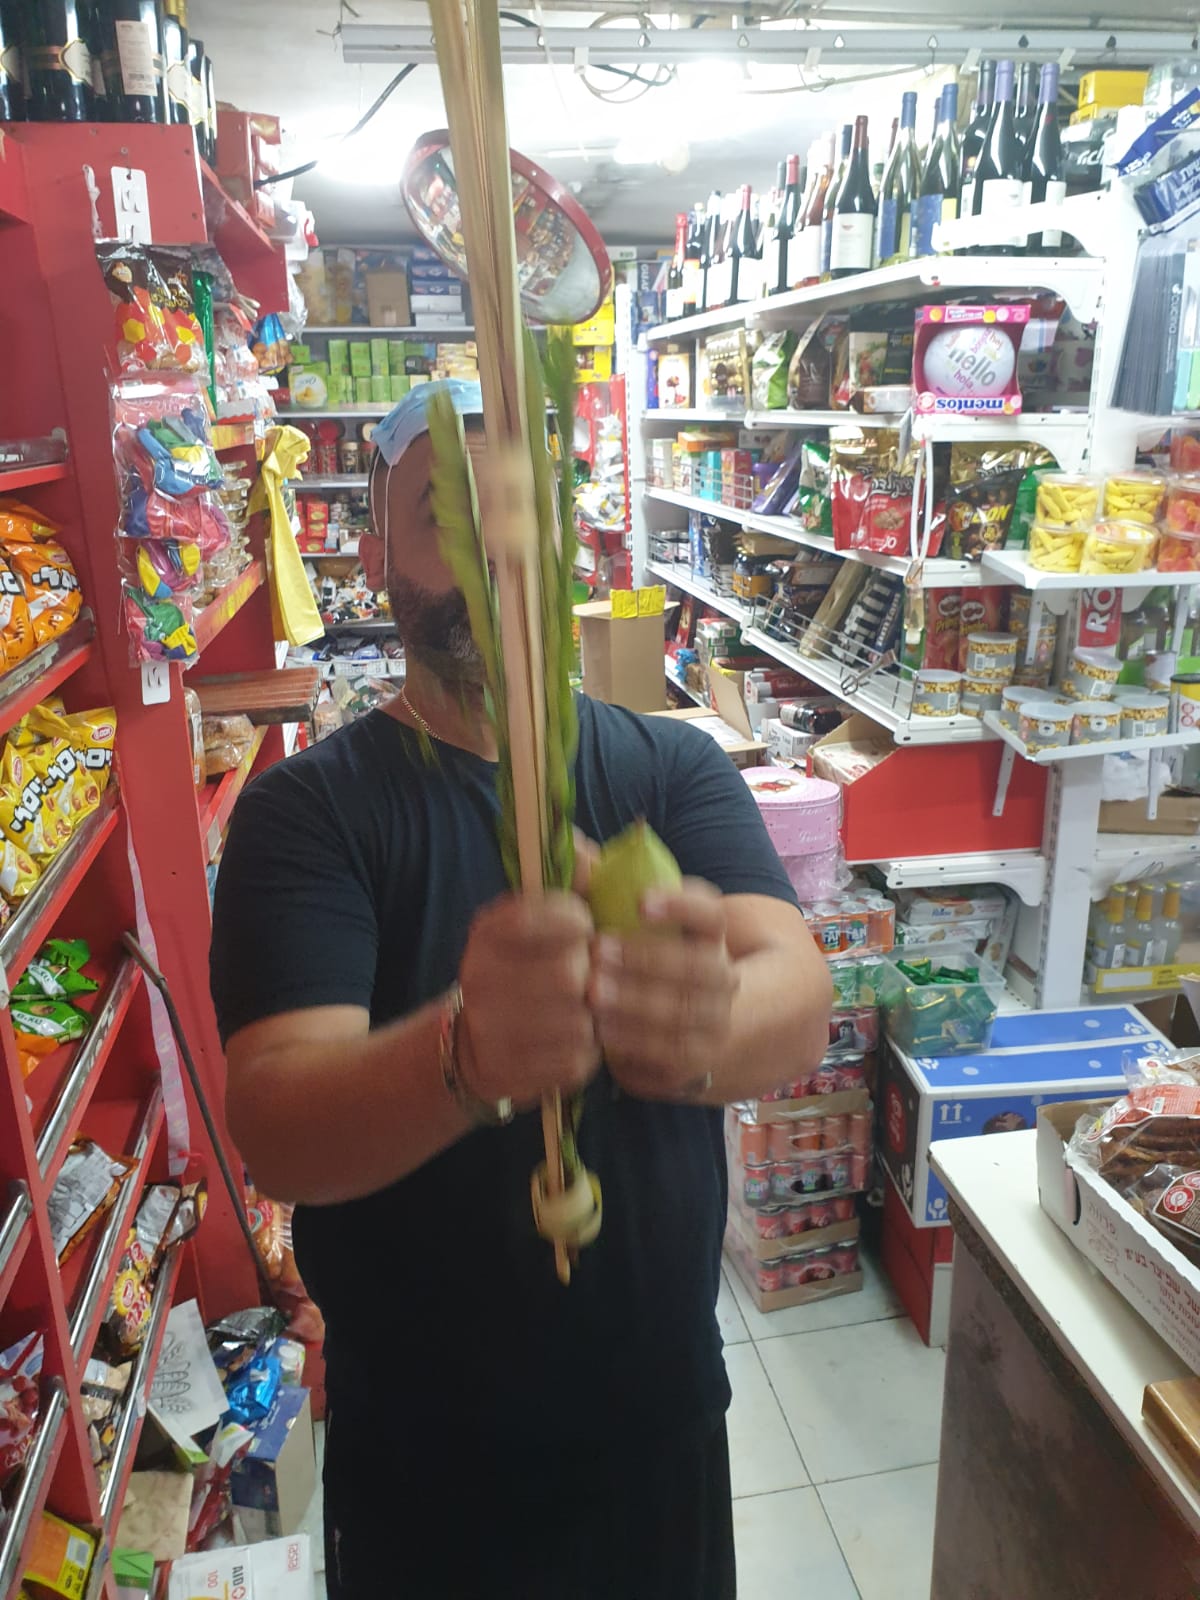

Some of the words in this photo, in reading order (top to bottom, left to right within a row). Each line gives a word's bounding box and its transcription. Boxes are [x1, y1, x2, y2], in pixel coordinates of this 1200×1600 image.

[1168, 295, 1180, 334] cucina
[953, 370, 974, 389] hola
[936, 399, 1003, 411] mentos
[971, 503, 1012, 523] LON
[208, 1569, 218, 1588] 100
